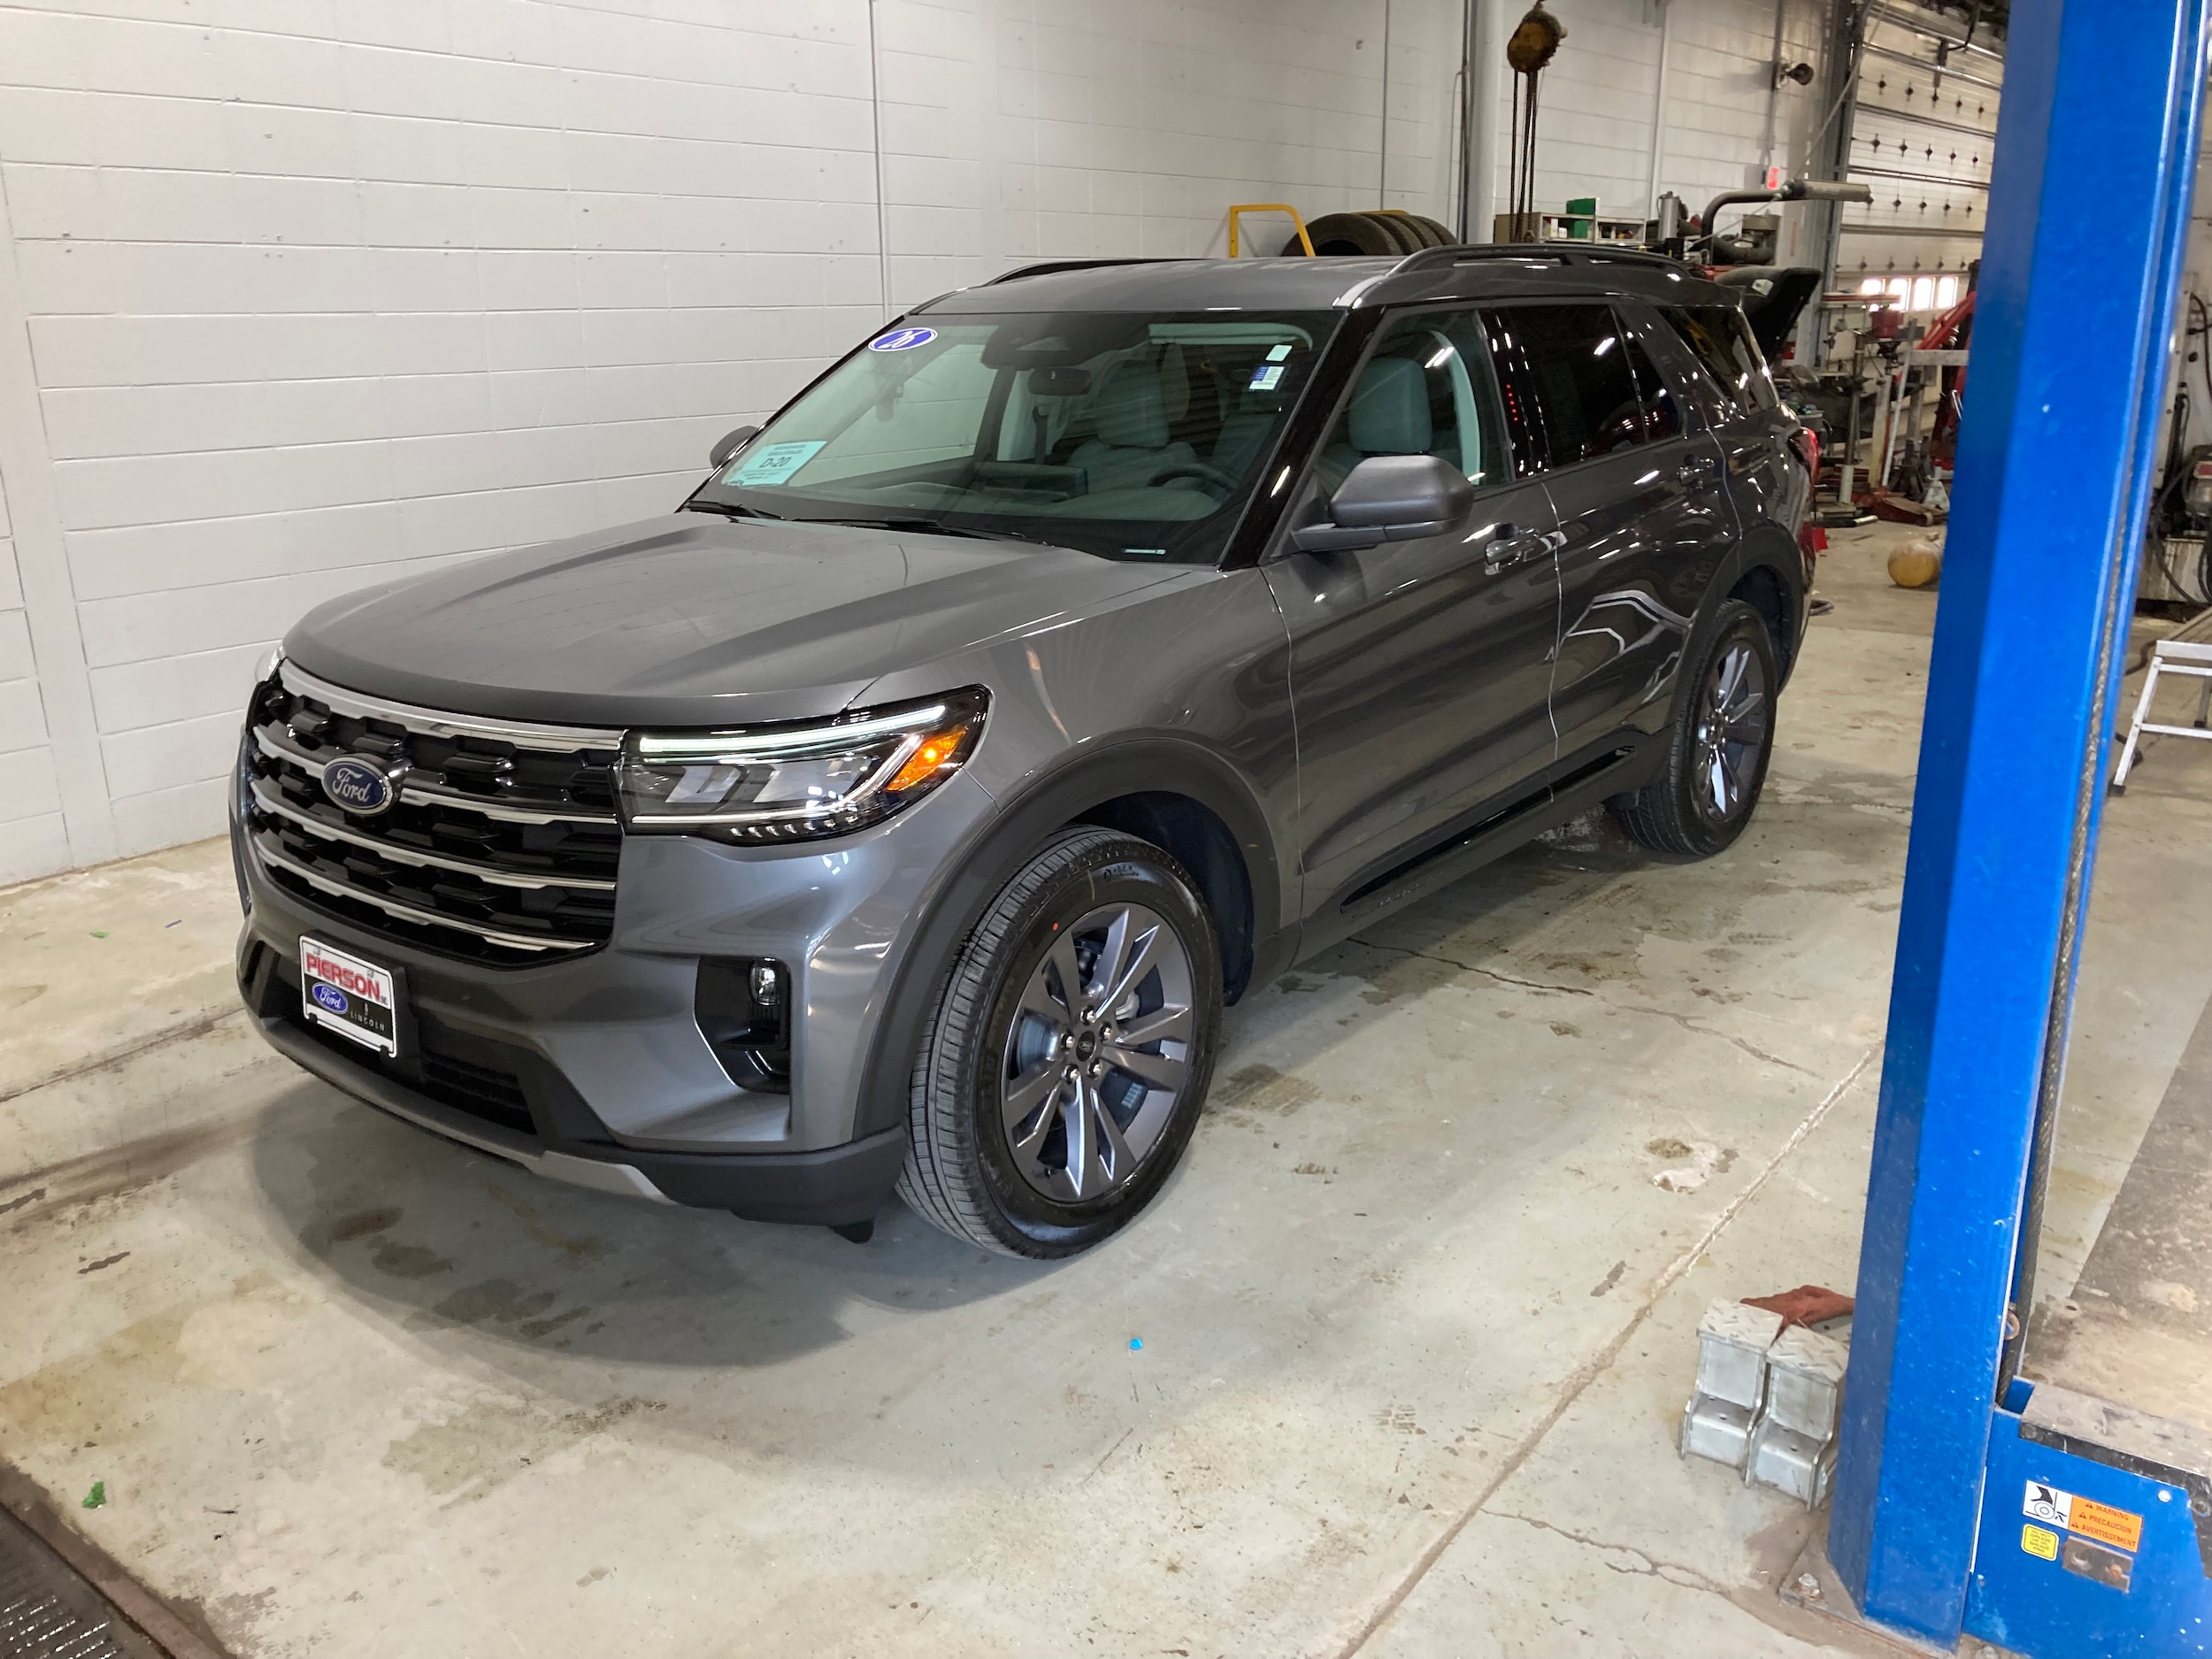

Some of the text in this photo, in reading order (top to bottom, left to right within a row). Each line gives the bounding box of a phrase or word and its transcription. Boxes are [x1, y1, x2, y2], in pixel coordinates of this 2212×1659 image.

[877, 330, 929, 349] 26
[758, 457, 792, 468] D-20
[332, 767, 372, 803] Ford
[305, 952, 380, 1002] PIERSON
[319, 987, 342, 1010] Ford
[350, 1011, 385, 1032] LINCOLN
[2096, 1504, 2129, 1521] WARNING
[2081, 1524, 2136, 1547] AVERTISSEMENT
